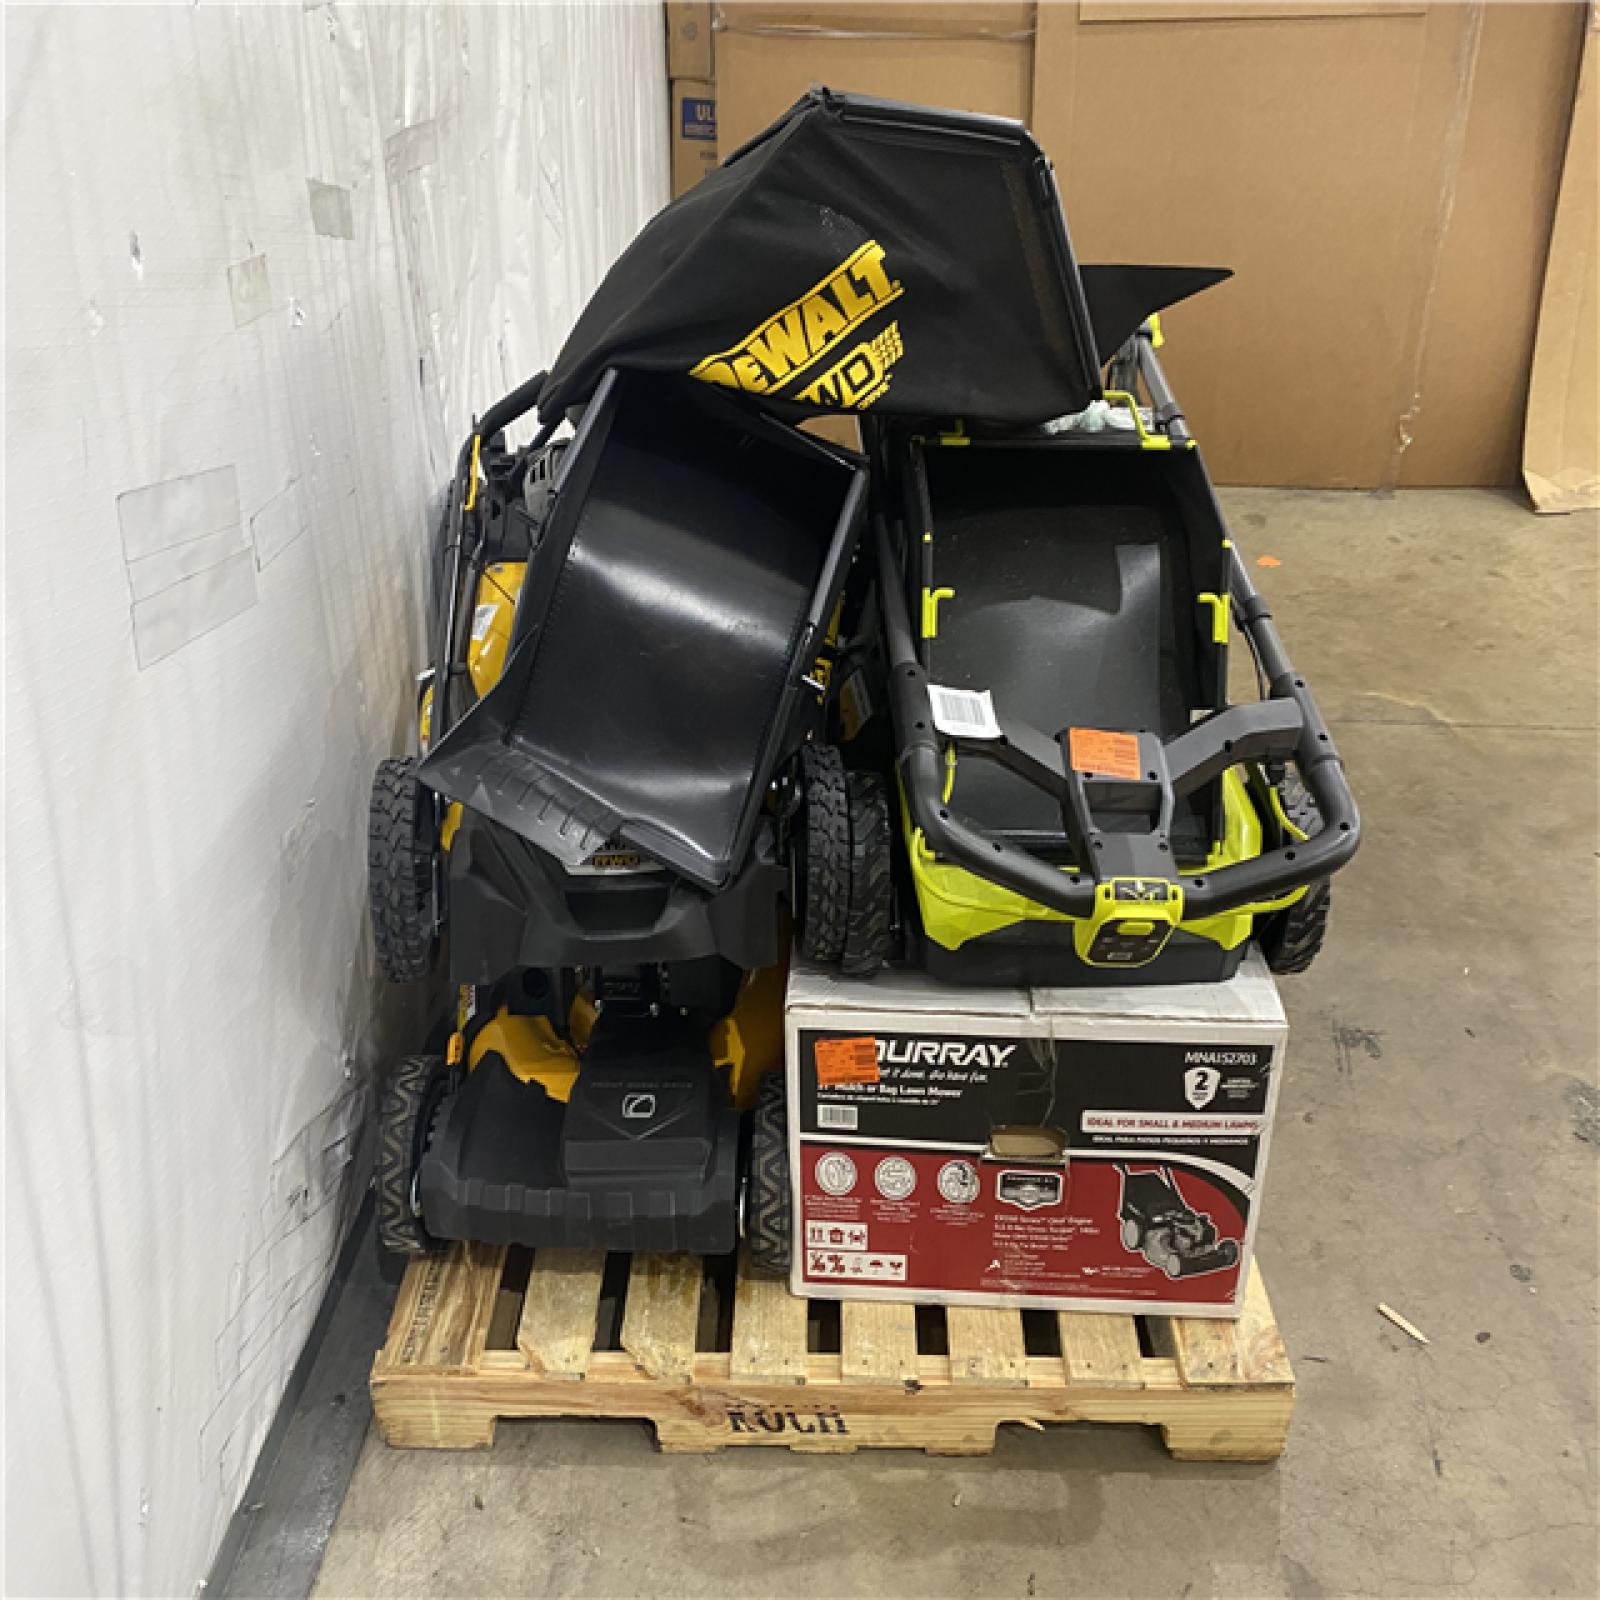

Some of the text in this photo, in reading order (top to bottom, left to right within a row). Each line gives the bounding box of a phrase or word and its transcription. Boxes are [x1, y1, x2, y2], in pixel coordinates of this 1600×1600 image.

[1194, 1070, 1208, 1091] 2
[1117, 1118, 1136, 1127] FOR
[1139, 1119, 1168, 1129] SMALL
